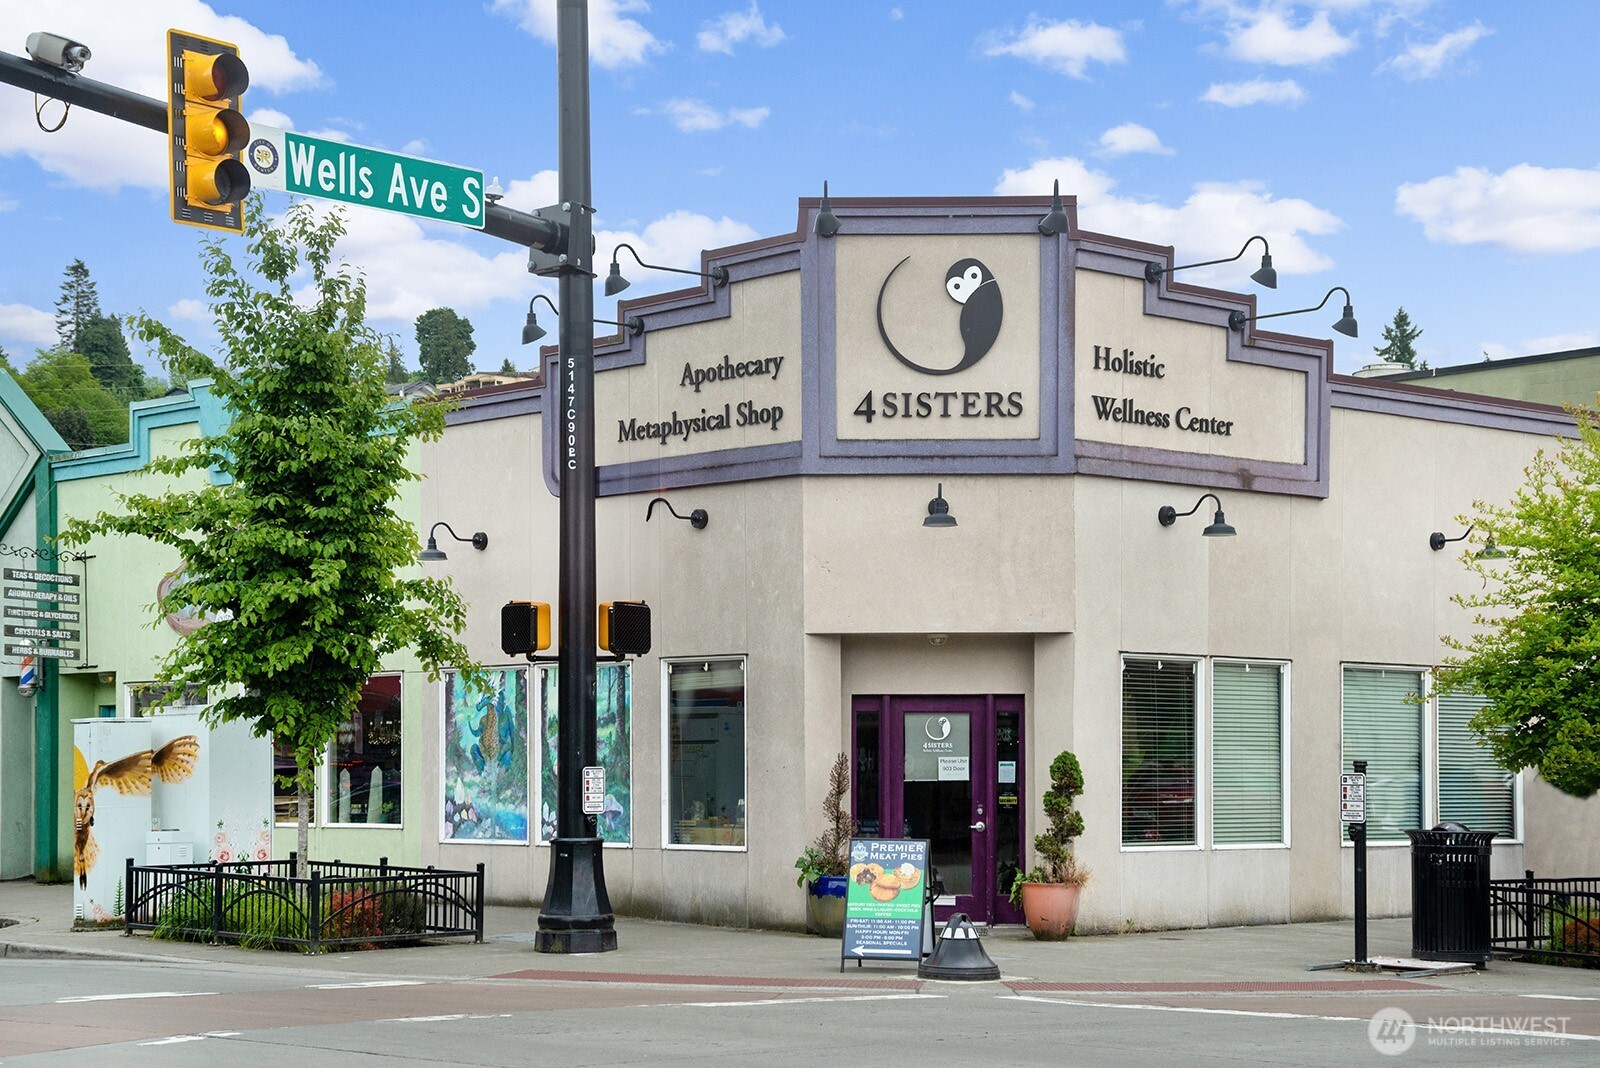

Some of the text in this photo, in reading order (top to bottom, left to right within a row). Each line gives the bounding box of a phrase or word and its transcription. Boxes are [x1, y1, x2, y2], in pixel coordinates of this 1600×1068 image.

[288, 140, 481, 219] Wells Ave S
[1093, 345, 1166, 380] Holistic
[679, 354, 784, 393] Apothecary
[853, 390, 1024, 424] 4 SISTERS
[617, 400, 784, 445] Metaphysical Shop
[1092, 395, 1234, 437] Wellness Center
[12, 570, 73, 584] TEAS & DECOCTIONS
[8, 589, 58, 601] AROMATHERAPY
[63, 594, 78, 603] OILS
[7, 608, 39, 618] TINCTURES
[44, 612, 78, 621] GLYCERIDES
[14, 627, 46, 637] CRYSTALS
[52, 630, 71, 639] SALTS
[12, 646, 33, 655] HERBS
[39, 648, 75, 658] BURNABLES
[870, 842, 924, 853] PREMIER
[870, 852, 923, 861] MEAT PIES
